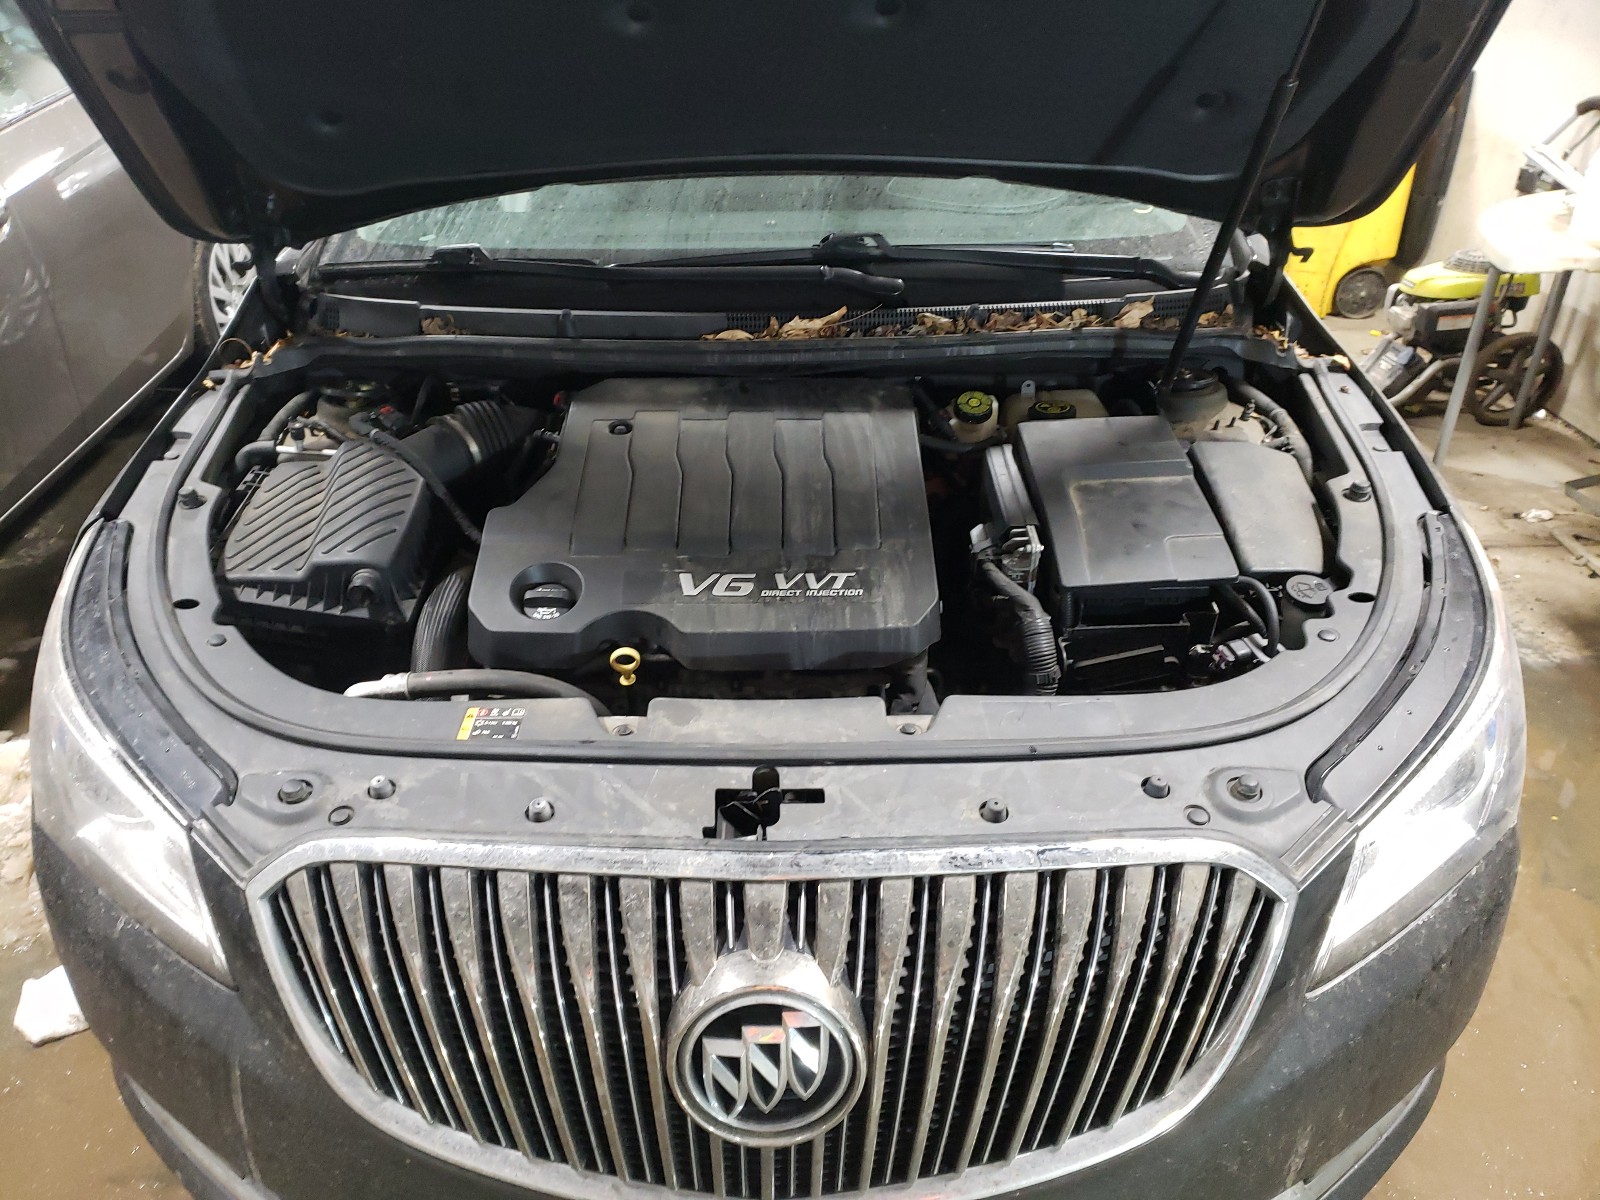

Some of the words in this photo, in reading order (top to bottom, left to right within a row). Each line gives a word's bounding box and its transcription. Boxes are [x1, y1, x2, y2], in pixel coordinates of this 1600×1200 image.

[679, 572, 757, 597] V6
[774, 572, 857, 590] VVT
[760, 589, 803, 597] DIRECT
[805, 588, 864, 597] INJECTION
